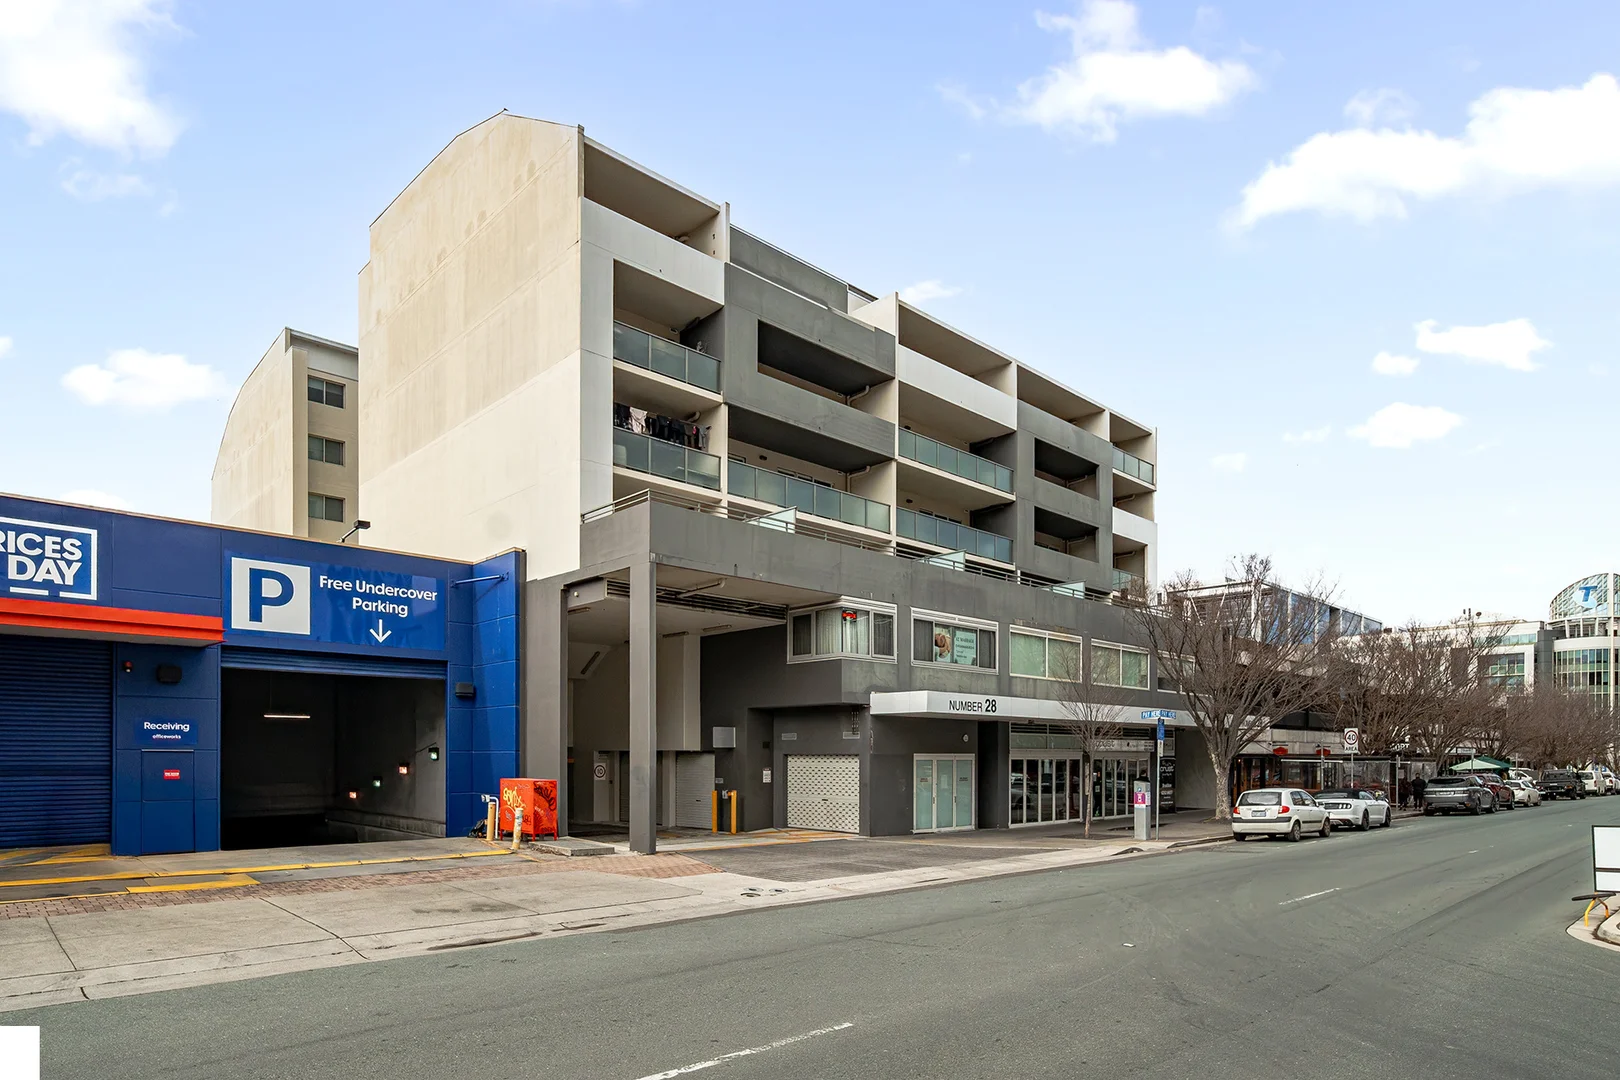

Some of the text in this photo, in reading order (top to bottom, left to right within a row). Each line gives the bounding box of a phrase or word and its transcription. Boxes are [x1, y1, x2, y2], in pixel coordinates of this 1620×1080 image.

[8, 554, 82, 586] DAY
[249, 567, 294, 623] P
[319, 575, 438, 601] Free Undercover
[352, 597, 408, 618] Parking
[949, 699, 997, 713] NUMBER 28
[1142, 711, 1150, 719] PAY
[144, 721, 190, 732] Receiving
[1347, 733, 1355, 741] 40
